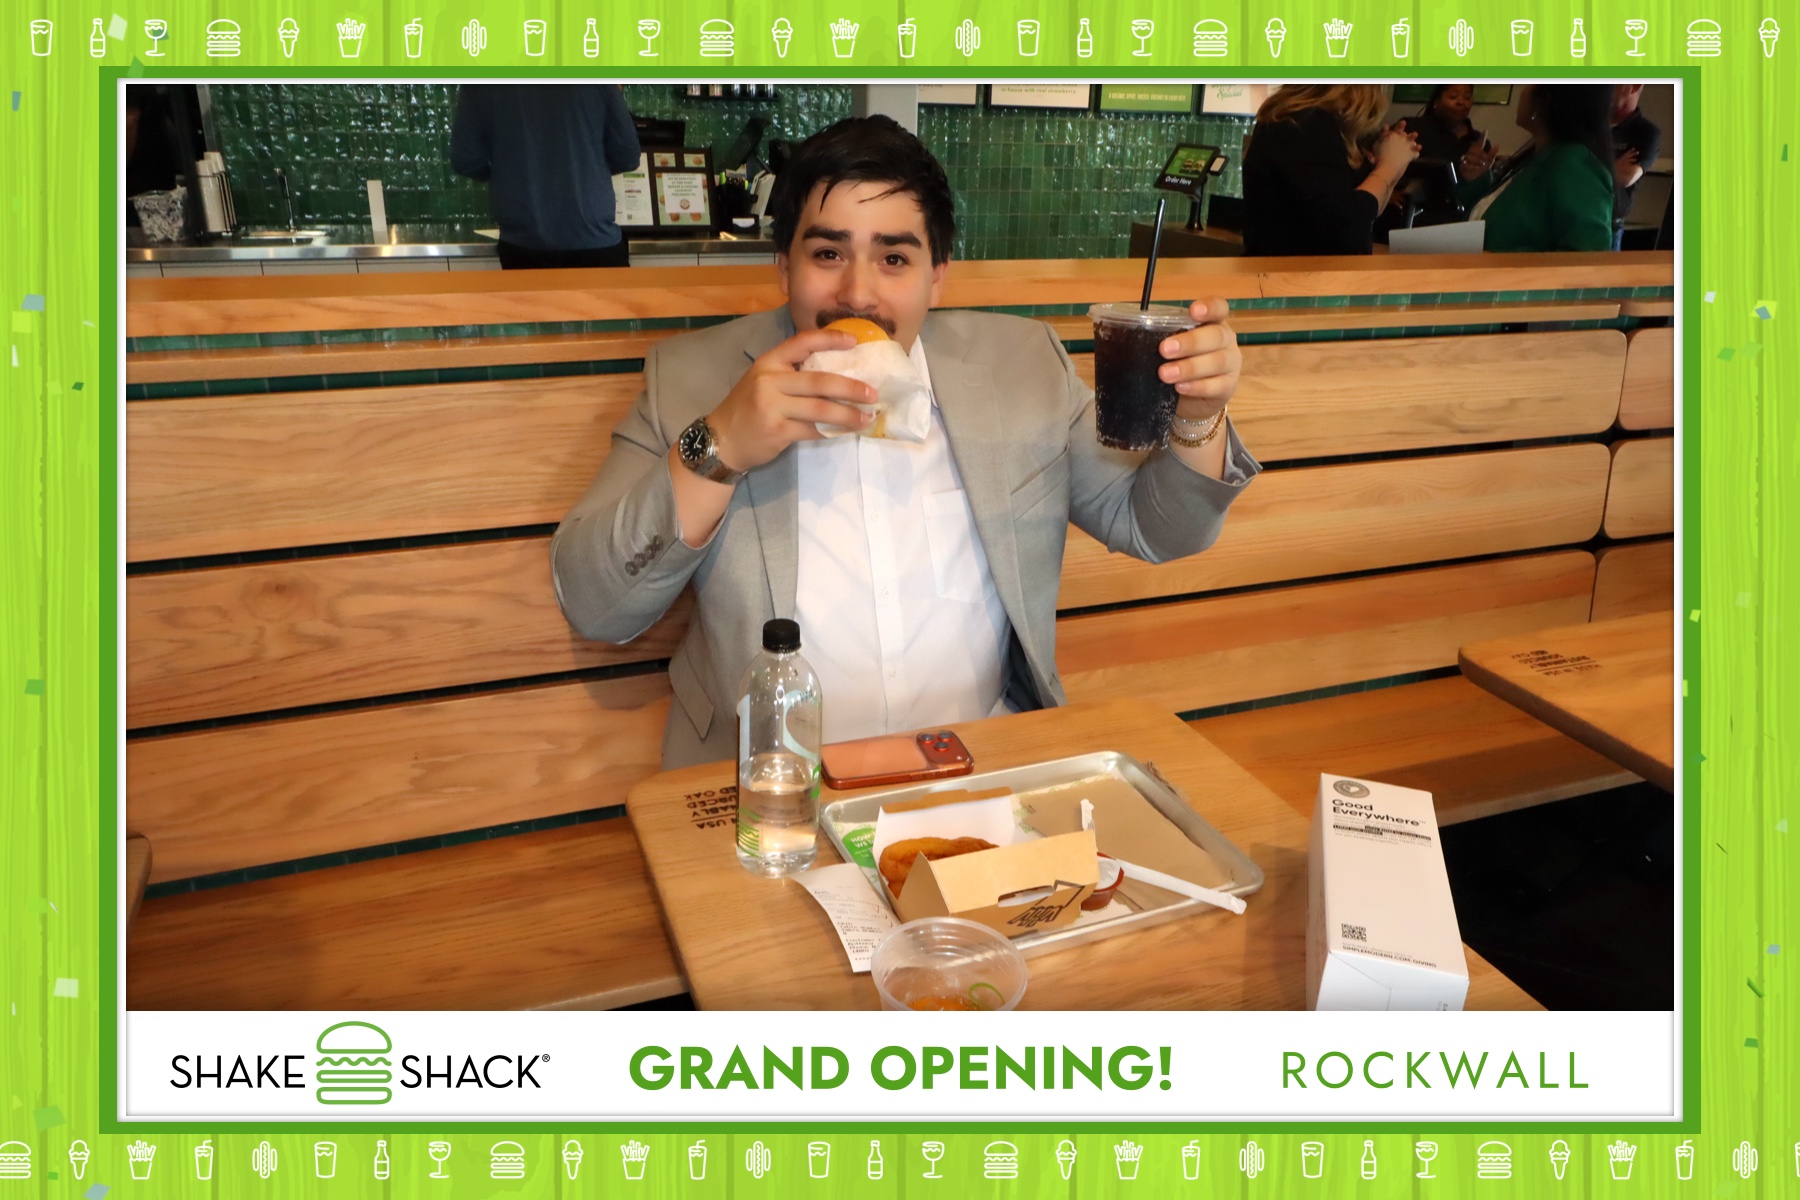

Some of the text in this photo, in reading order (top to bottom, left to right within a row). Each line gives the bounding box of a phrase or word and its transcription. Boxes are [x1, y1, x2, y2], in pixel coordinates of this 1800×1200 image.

[1216, 87, 1243, 101] Special
[1165, 175, 1192, 185] Order Here
[684, 790, 716, 801] OAK
[687, 795, 737, 809] URCED
[1332, 798, 1374, 811] Good
[696, 819, 727, 830] USA
